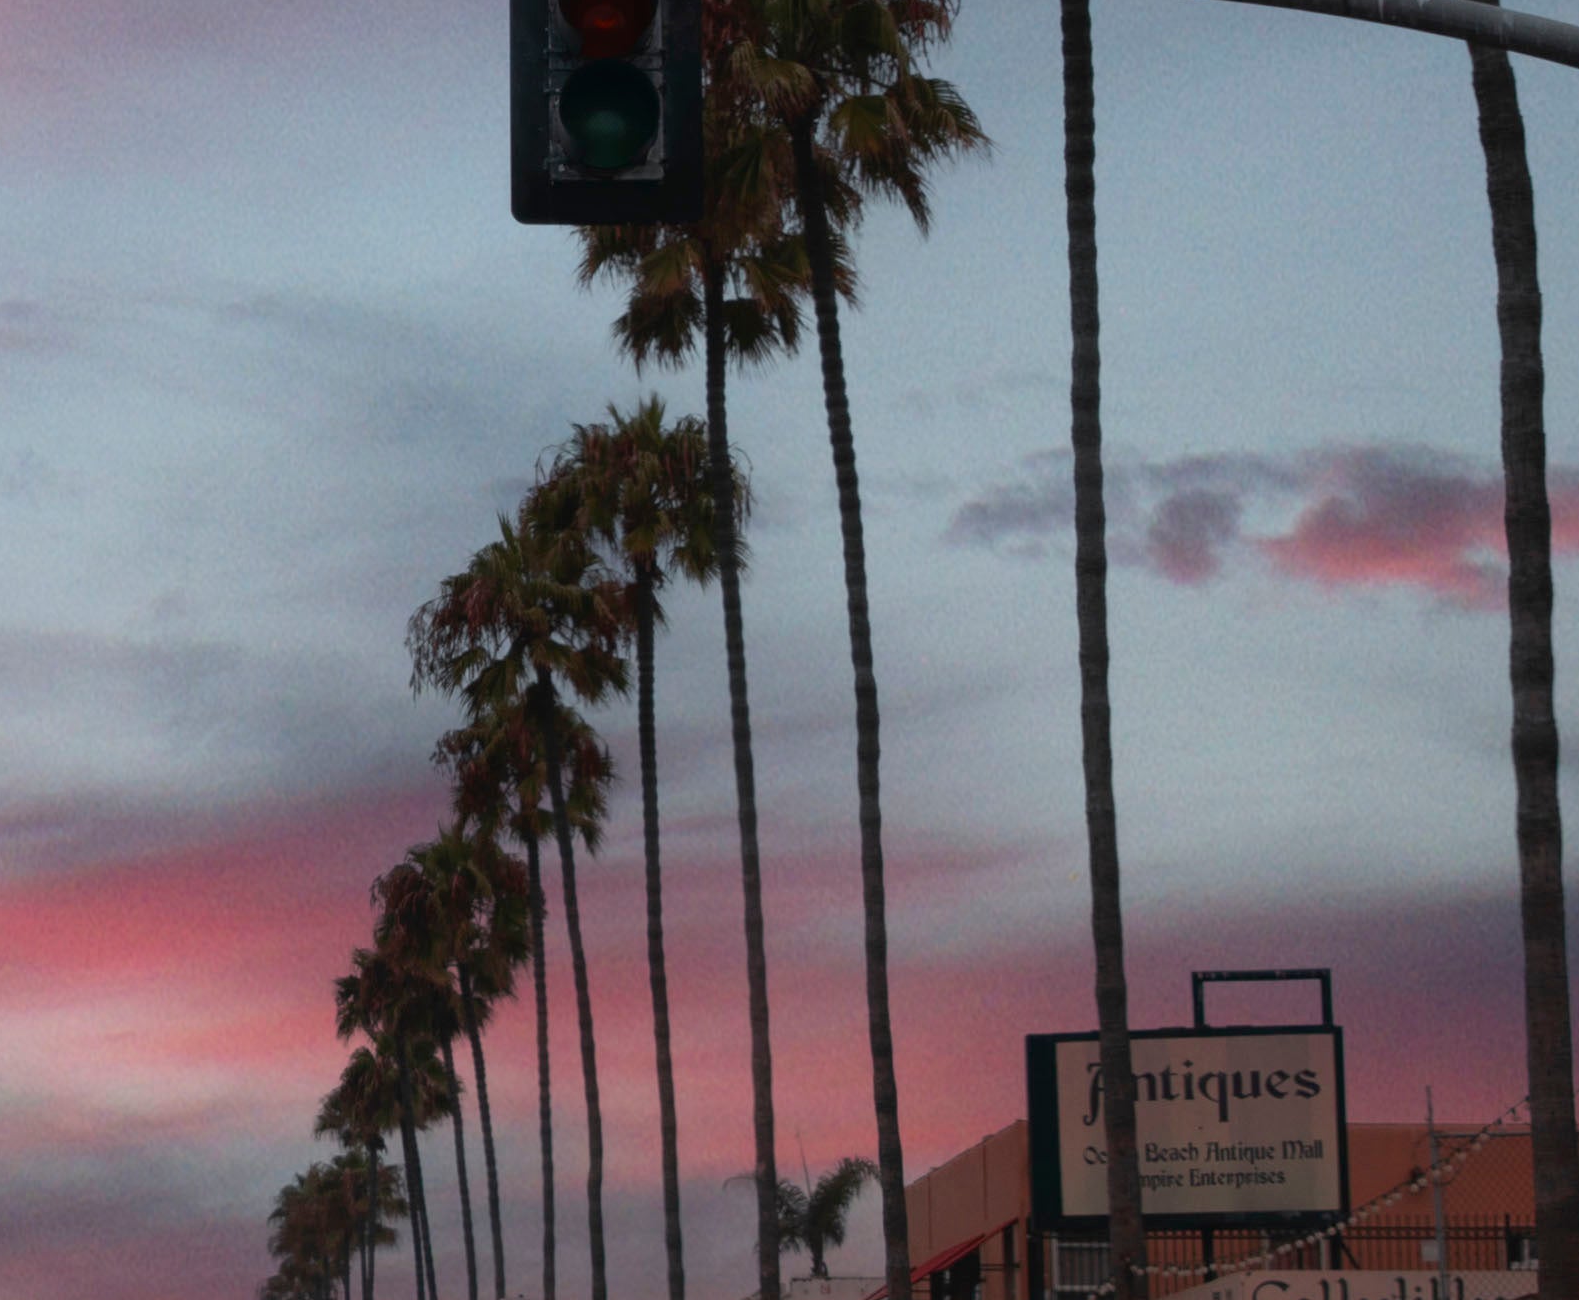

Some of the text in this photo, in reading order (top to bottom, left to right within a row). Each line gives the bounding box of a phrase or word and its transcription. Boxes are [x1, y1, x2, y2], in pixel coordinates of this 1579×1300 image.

[1144, 1139, 1323, 1164] Beach Antique Mall
[1138, 1167, 1286, 1191] mpire Enterprises
